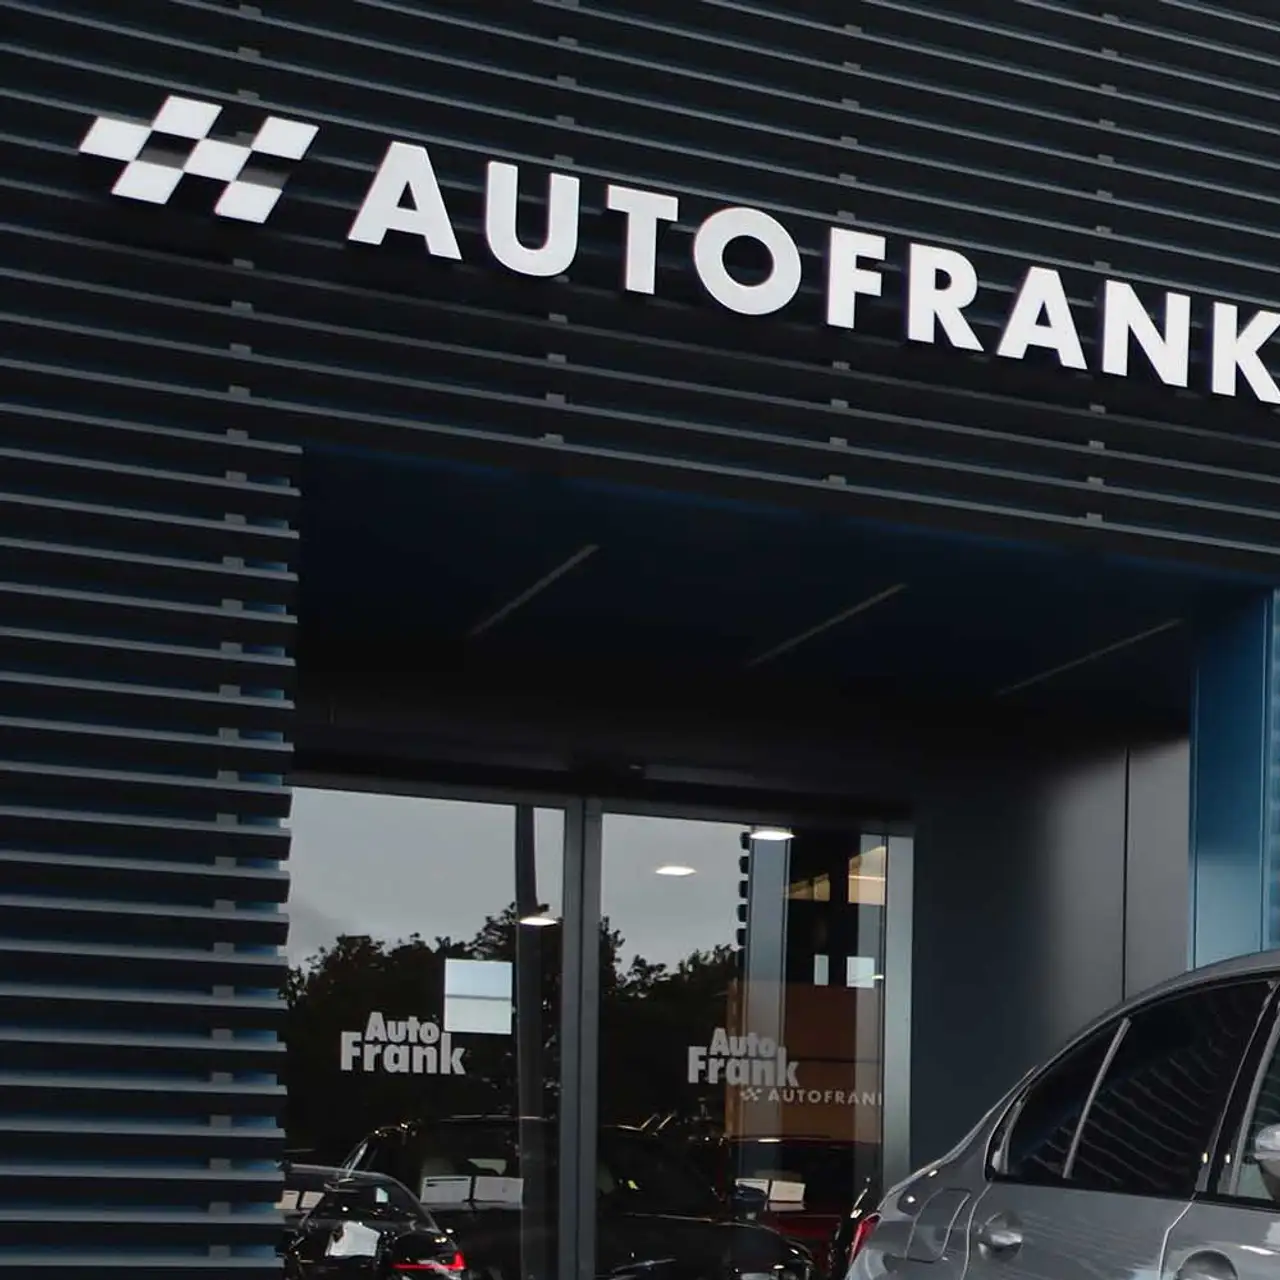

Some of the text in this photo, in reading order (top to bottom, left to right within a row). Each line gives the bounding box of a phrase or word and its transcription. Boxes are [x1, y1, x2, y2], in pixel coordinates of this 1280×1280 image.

[365, 1011, 440, 1044] Auto
[709, 1027, 778, 1057] Auto
[340, 1031, 466, 1075] Frank
[687, 1046, 800, 1087] Frank
